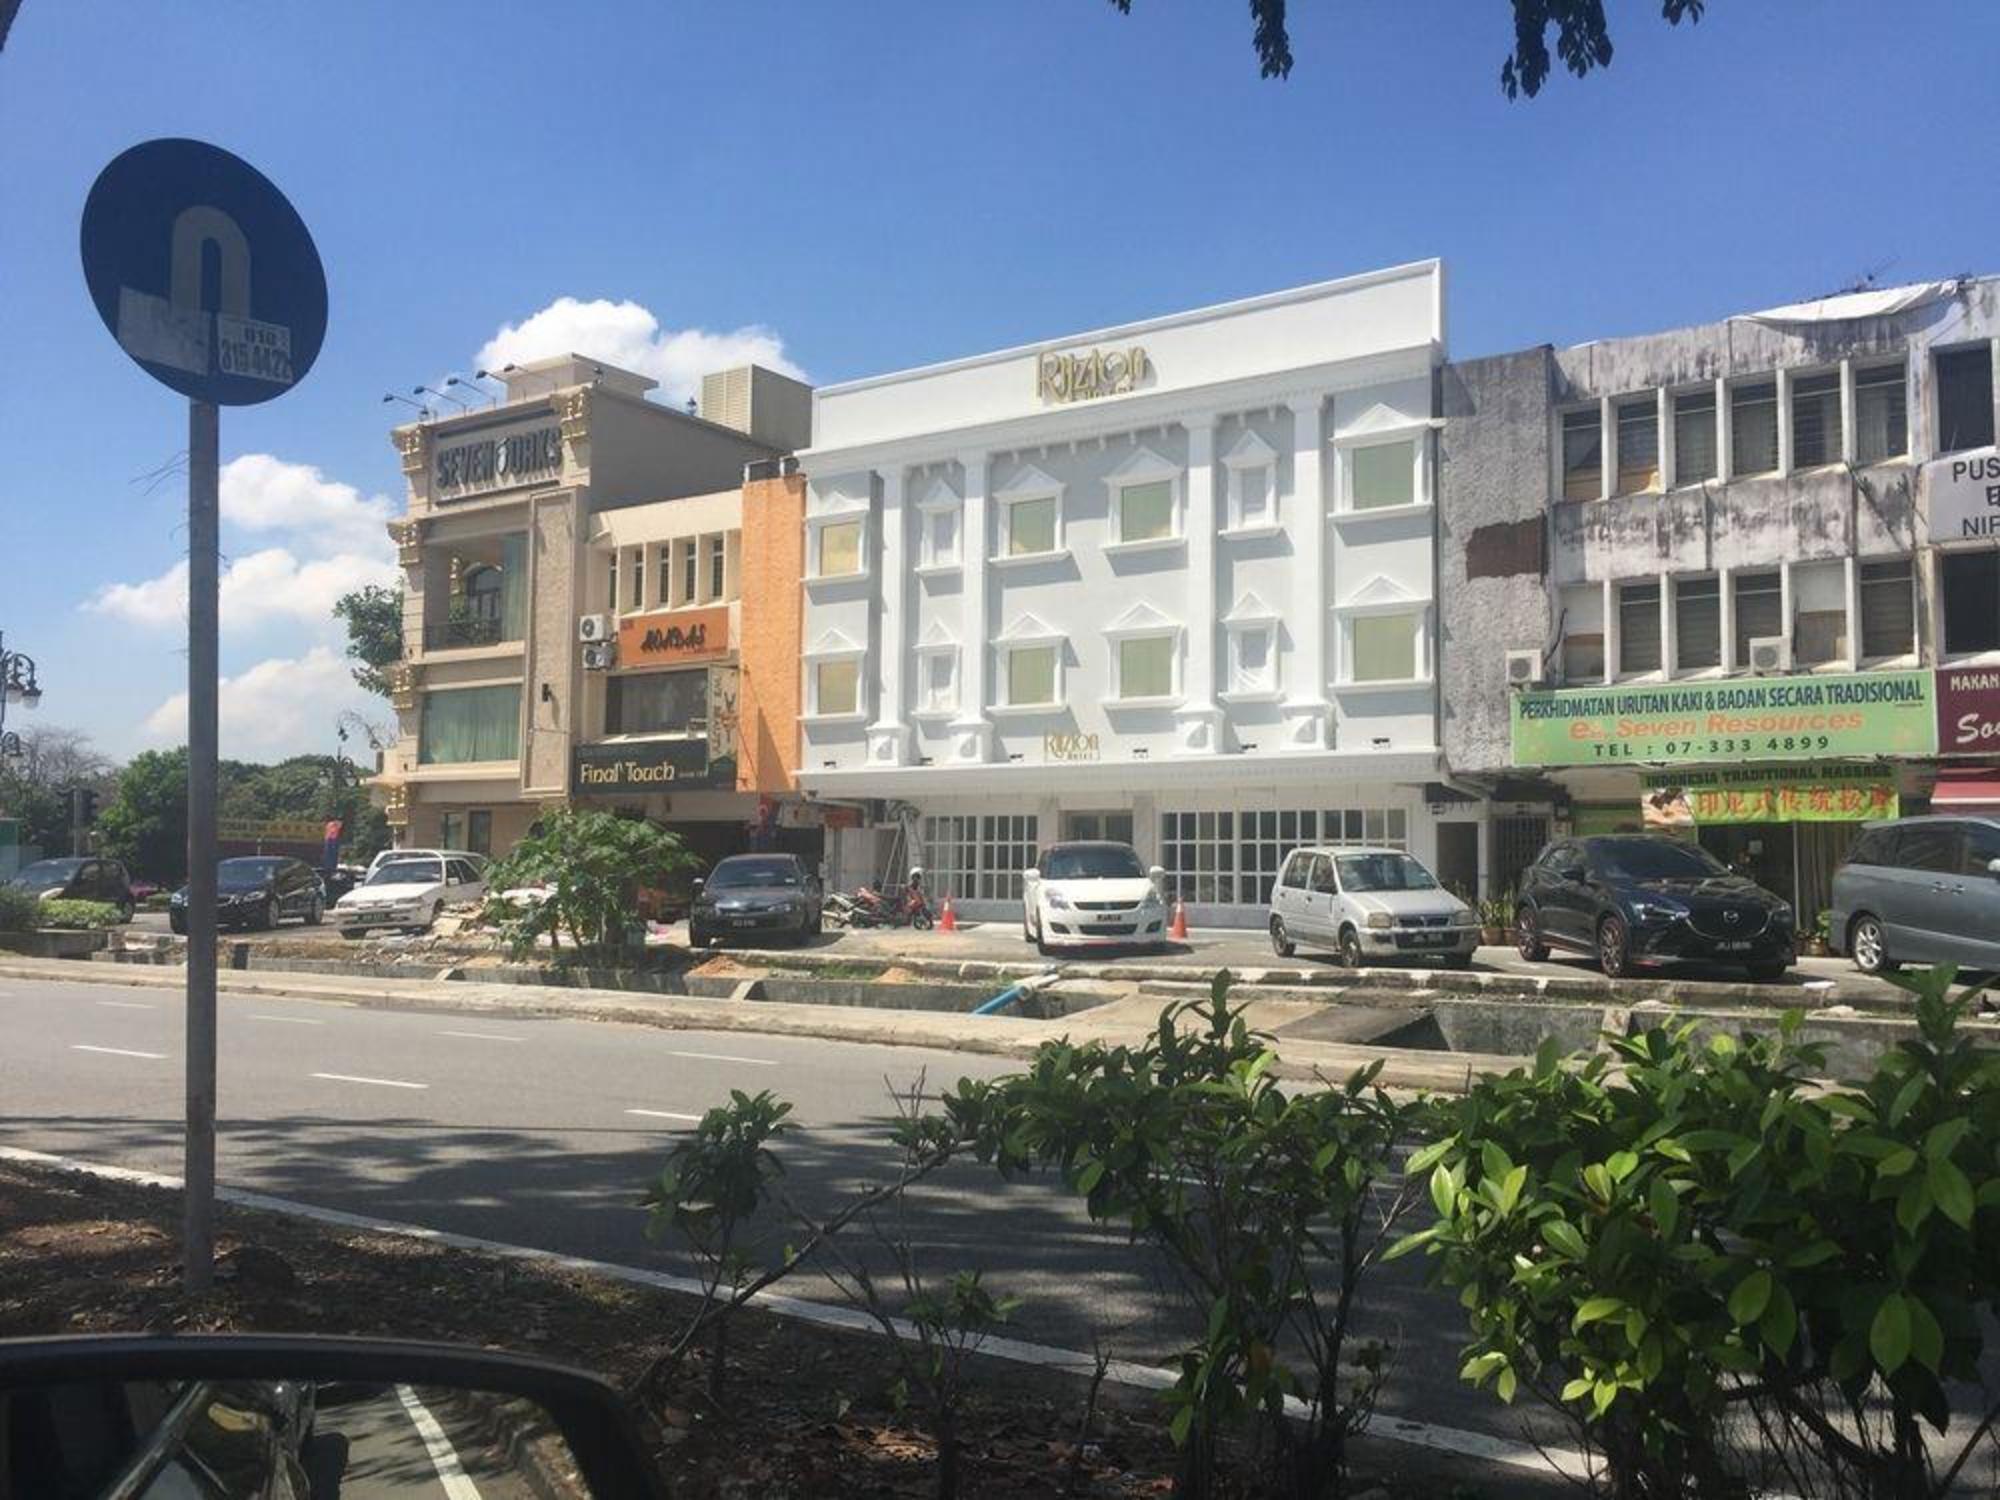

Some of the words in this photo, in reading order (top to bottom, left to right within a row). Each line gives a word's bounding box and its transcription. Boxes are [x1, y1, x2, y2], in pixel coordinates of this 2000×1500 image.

[1519, 697, 1615, 720] PERKHIDMATAN
[1617, 693, 1670, 716] URUTAN
[1671, 692, 1702, 712] KAKI
[1705, 690, 1716, 709] &
[1717, 688, 1767, 710] BADAN
[1769, 685, 1823, 707] SECARA
[1825, 679, 1925, 704] TRADISIONAL
[1616, 718, 1698, 738] Seven
[1707, 712, 1864, 734] Resources
[1594, 743, 1633, 757] TEL
[1665, 738, 1751, 755] 07-333
[1766, 735, 1829, 751] 4899
[580, 762, 620, 785] Final
[625, 761, 675, 782] Touch
[1646, 771, 1718, 788] INDONESIA
[1721, 766, 1816, 783] TRADITIONAL
